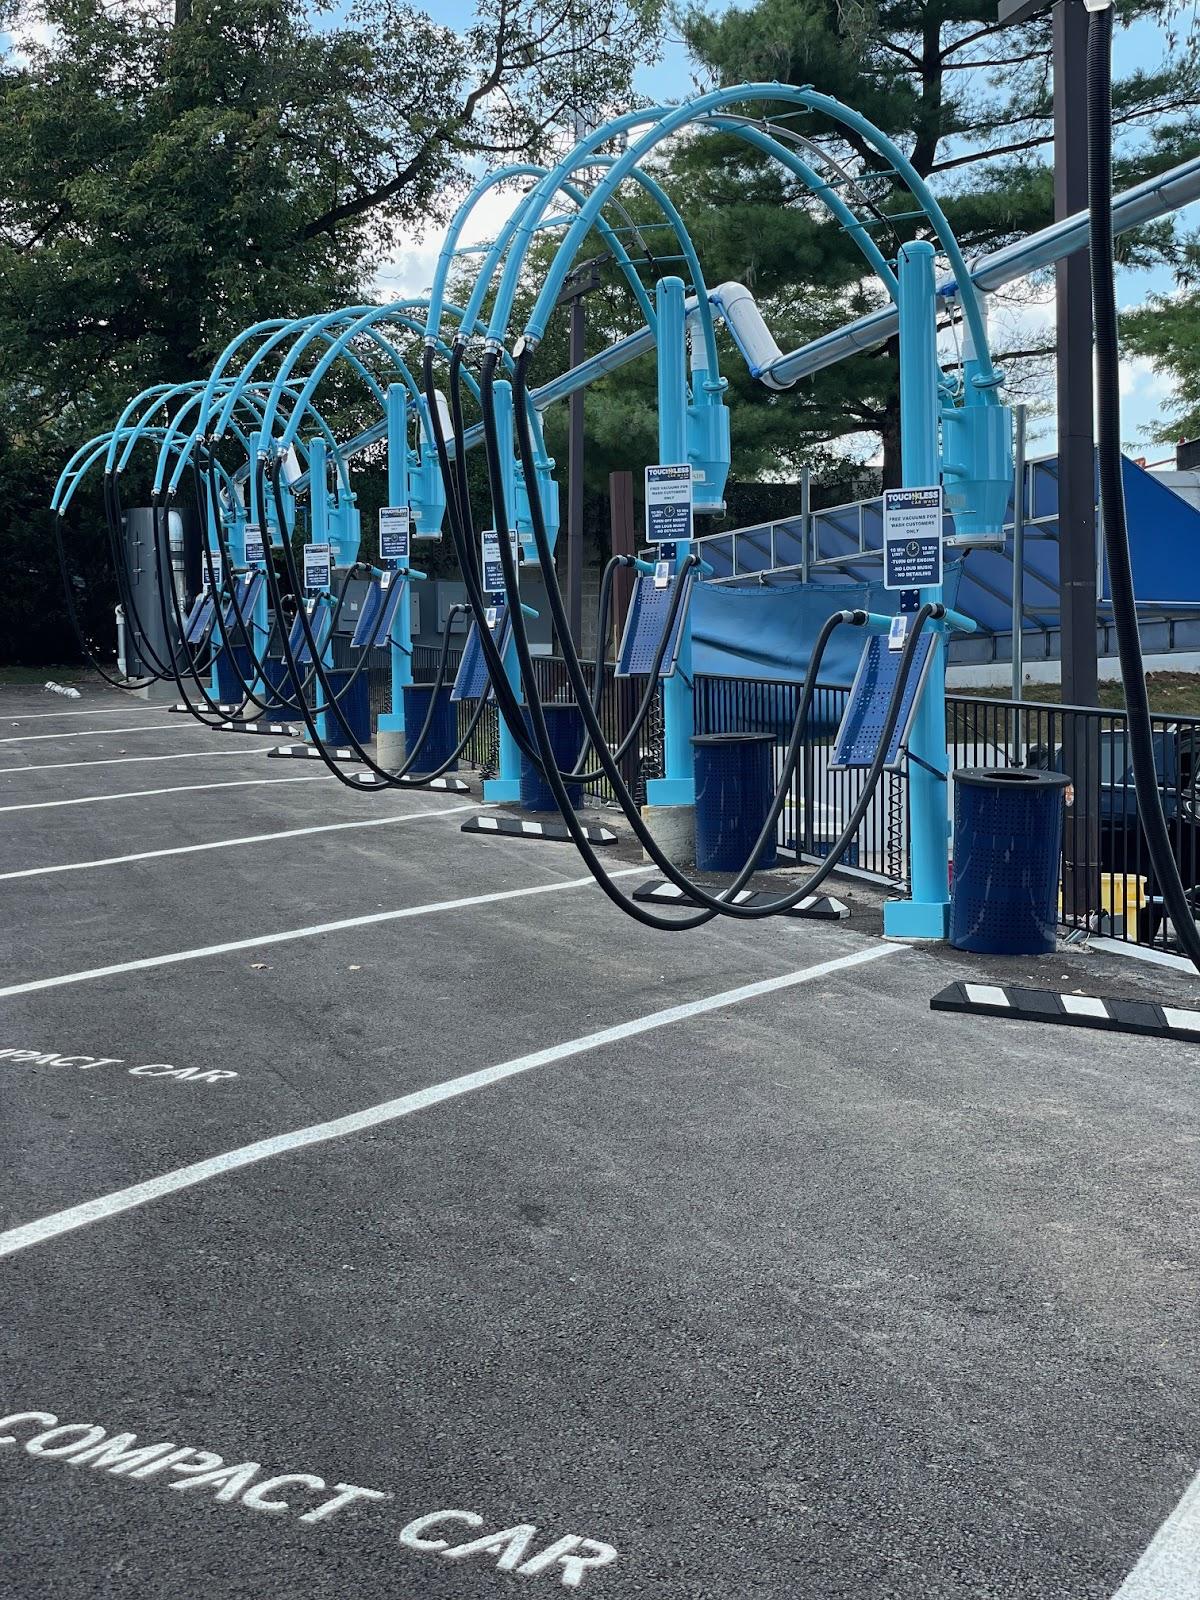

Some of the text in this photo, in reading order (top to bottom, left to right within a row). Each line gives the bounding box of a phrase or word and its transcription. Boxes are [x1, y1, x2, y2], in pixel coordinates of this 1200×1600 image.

[128, 1064, 238, 1083] CAR
[0, 1411, 617, 1586] COMPACT CAR
